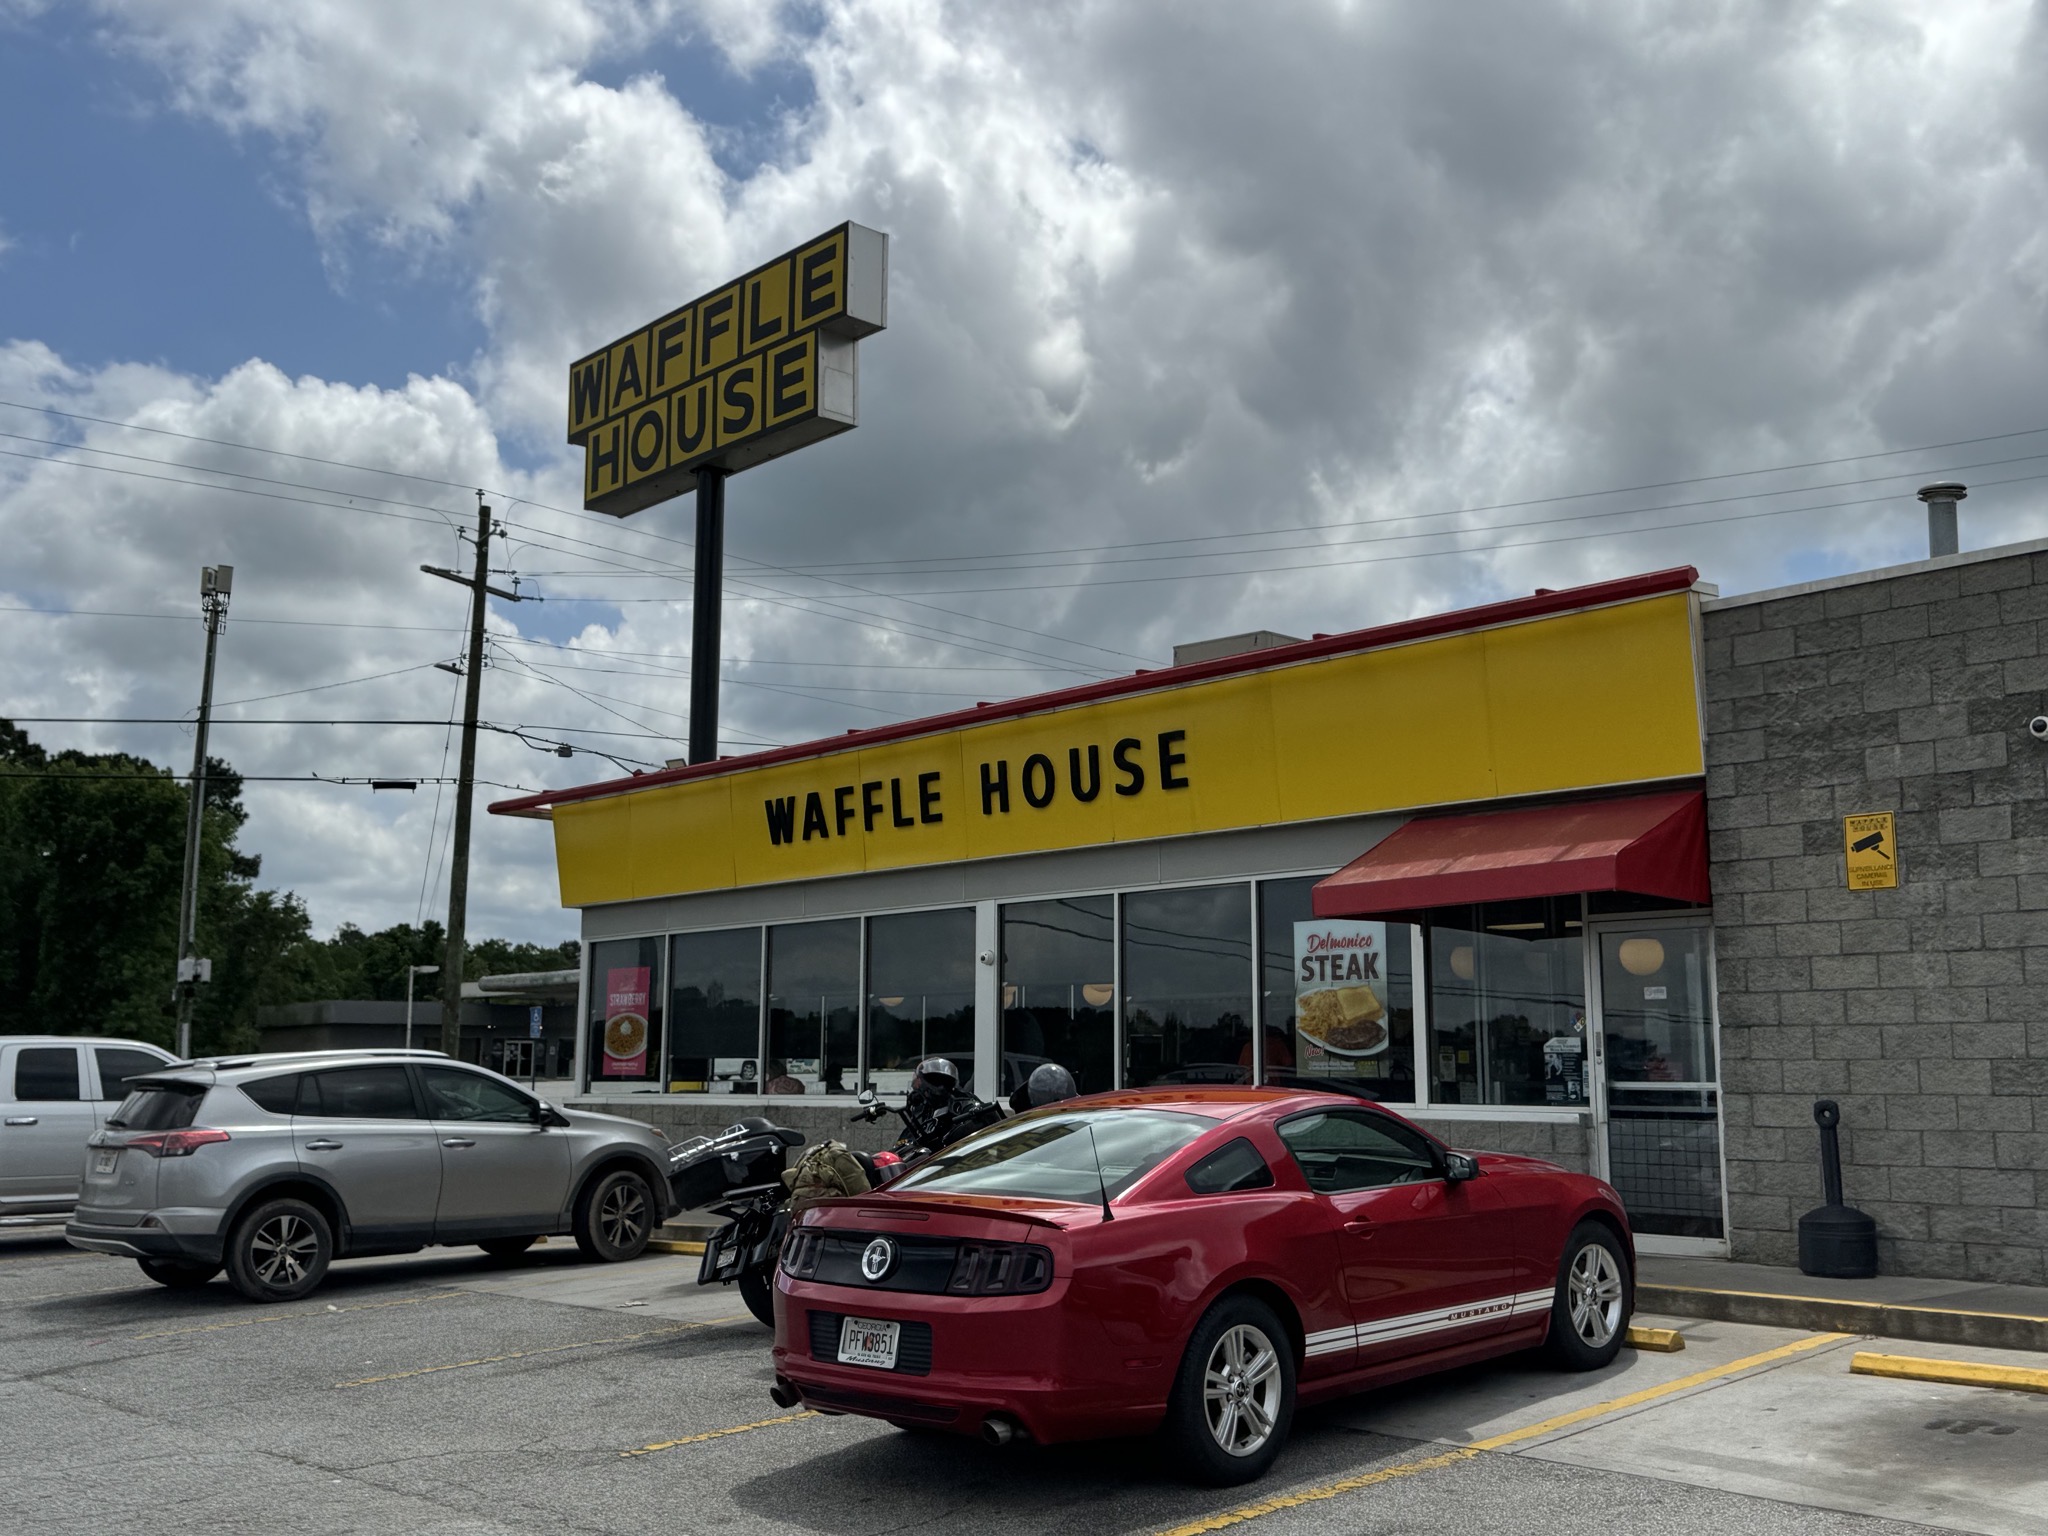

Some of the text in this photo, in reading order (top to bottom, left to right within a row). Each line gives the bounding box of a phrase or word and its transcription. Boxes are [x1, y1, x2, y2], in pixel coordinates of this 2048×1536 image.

[573, 242, 837, 426] WAFFLE
[591, 341, 808, 494] HOUSE
[764, 730, 1189, 845] WAFFLE HOUSE
[1849, 864, 1893, 872] SURVEILLANCE
[1307, 932, 1372, 953] Delmonico
[1301, 952, 1379, 982] STEAK
[1450, 1303, 1508, 1320] MUSTANG
[857, 1321, 887, 1332] GEORGIA
[846, 1356, 885, 1365] Mustang
